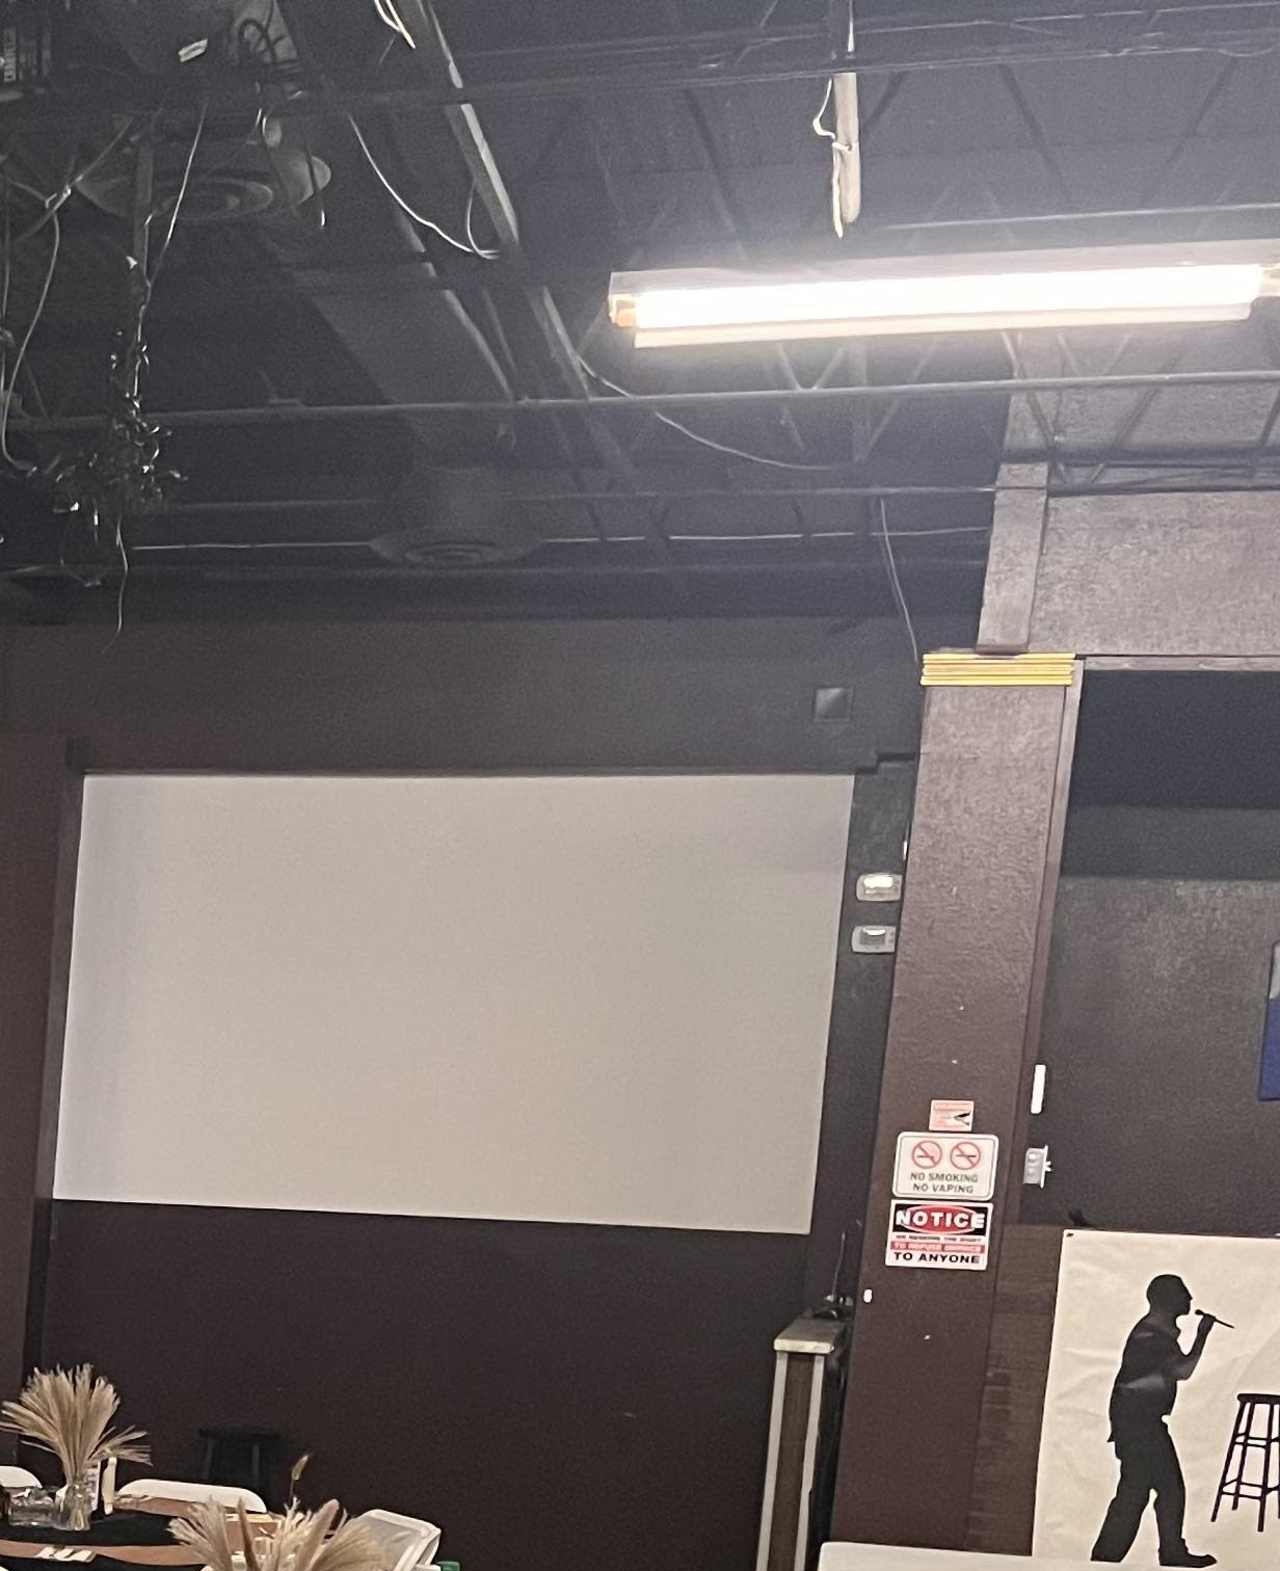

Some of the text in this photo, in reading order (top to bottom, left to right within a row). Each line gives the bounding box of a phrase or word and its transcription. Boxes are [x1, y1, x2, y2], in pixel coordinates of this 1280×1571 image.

[910, 1172, 979, 1183] NO SMOKING
[913, 1183, 974, 1194] NO VAPING
[895, 1210, 985, 1229] NOTICE
[894, 1252, 980, 1264] TO ANYONE
